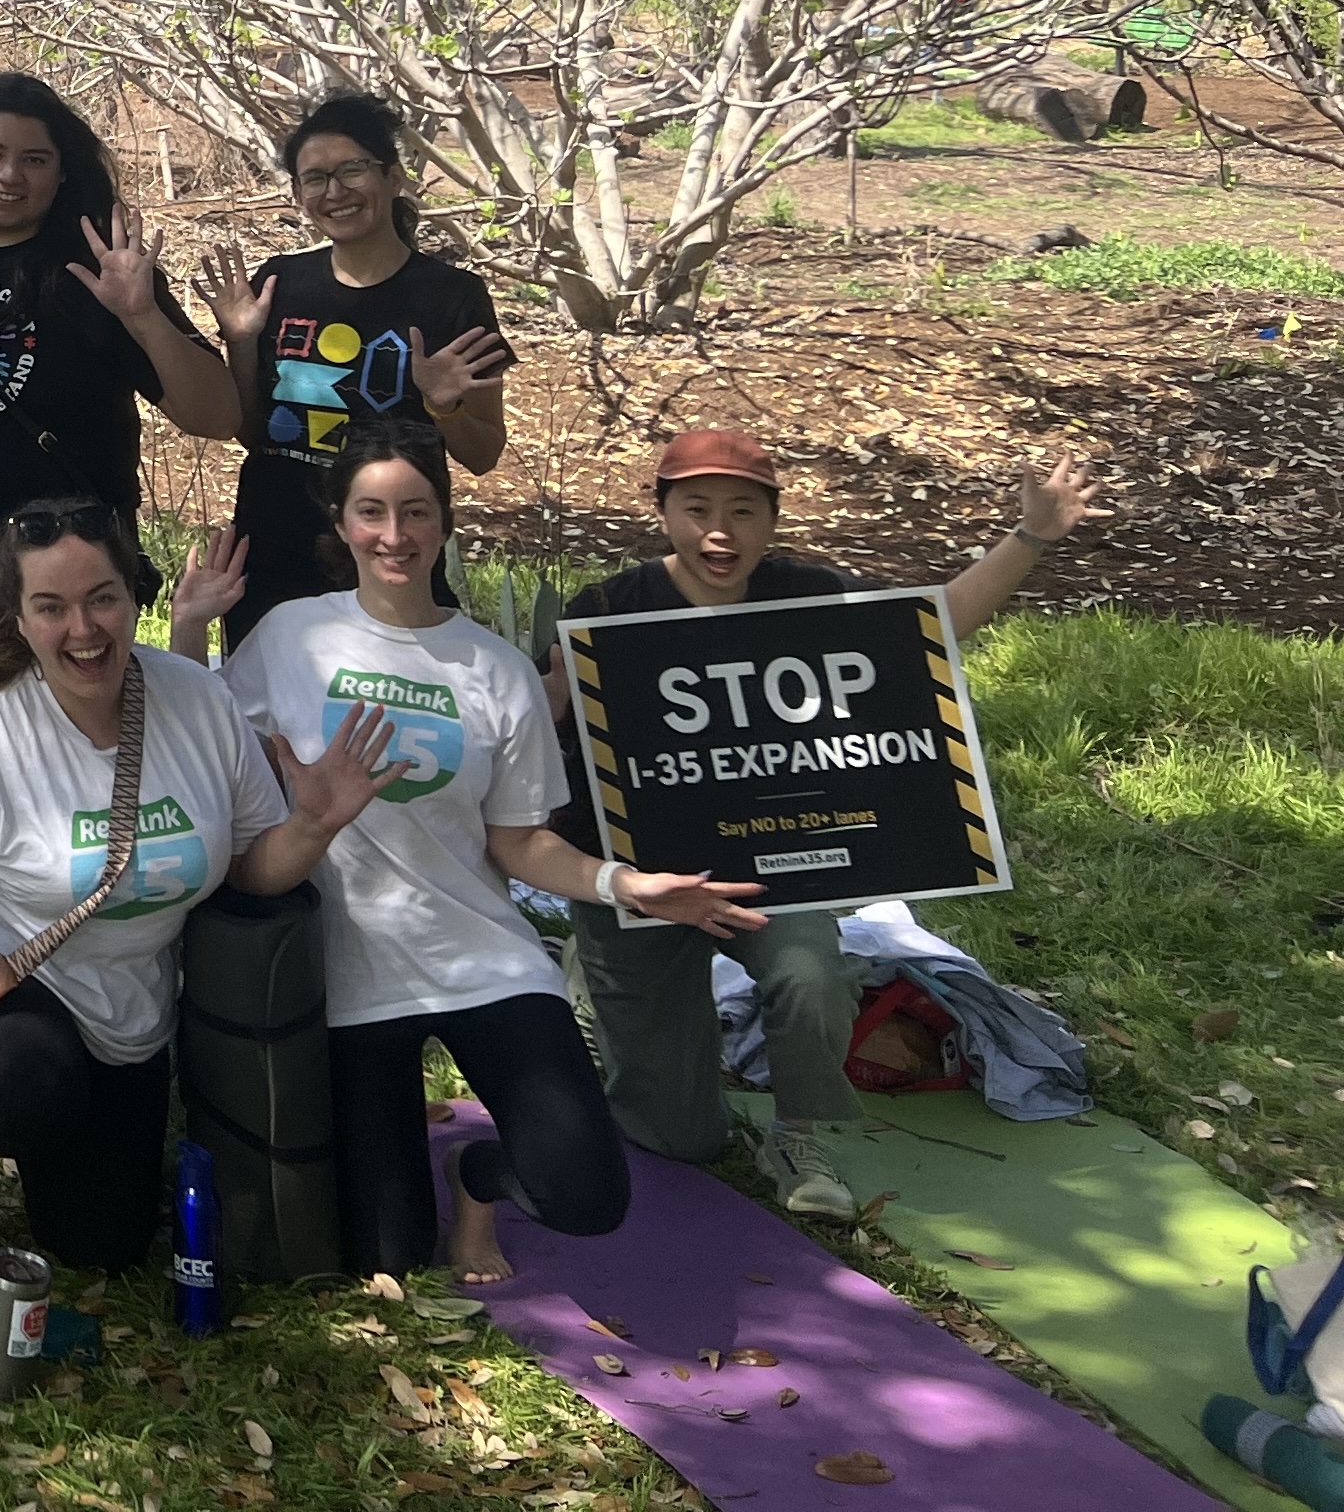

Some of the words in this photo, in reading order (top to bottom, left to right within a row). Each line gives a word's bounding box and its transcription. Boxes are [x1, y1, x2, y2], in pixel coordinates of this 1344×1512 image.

[338, 675, 450, 713] Rethink
[658, 651, 876, 734] STOP
[627, 750, 703, 789] I-35
[711, 728, 937, 781] EXPANSION
[79, 804, 182, 843] Reink
[716, 820, 748, 838] Say
[750, 817, 776, 833] NO
[779, 814, 796, 830] to
[799, 812, 831, 829] 20+
[834, 809, 877, 826] lanes
[758, 850, 847, 871] Rethink35.org
